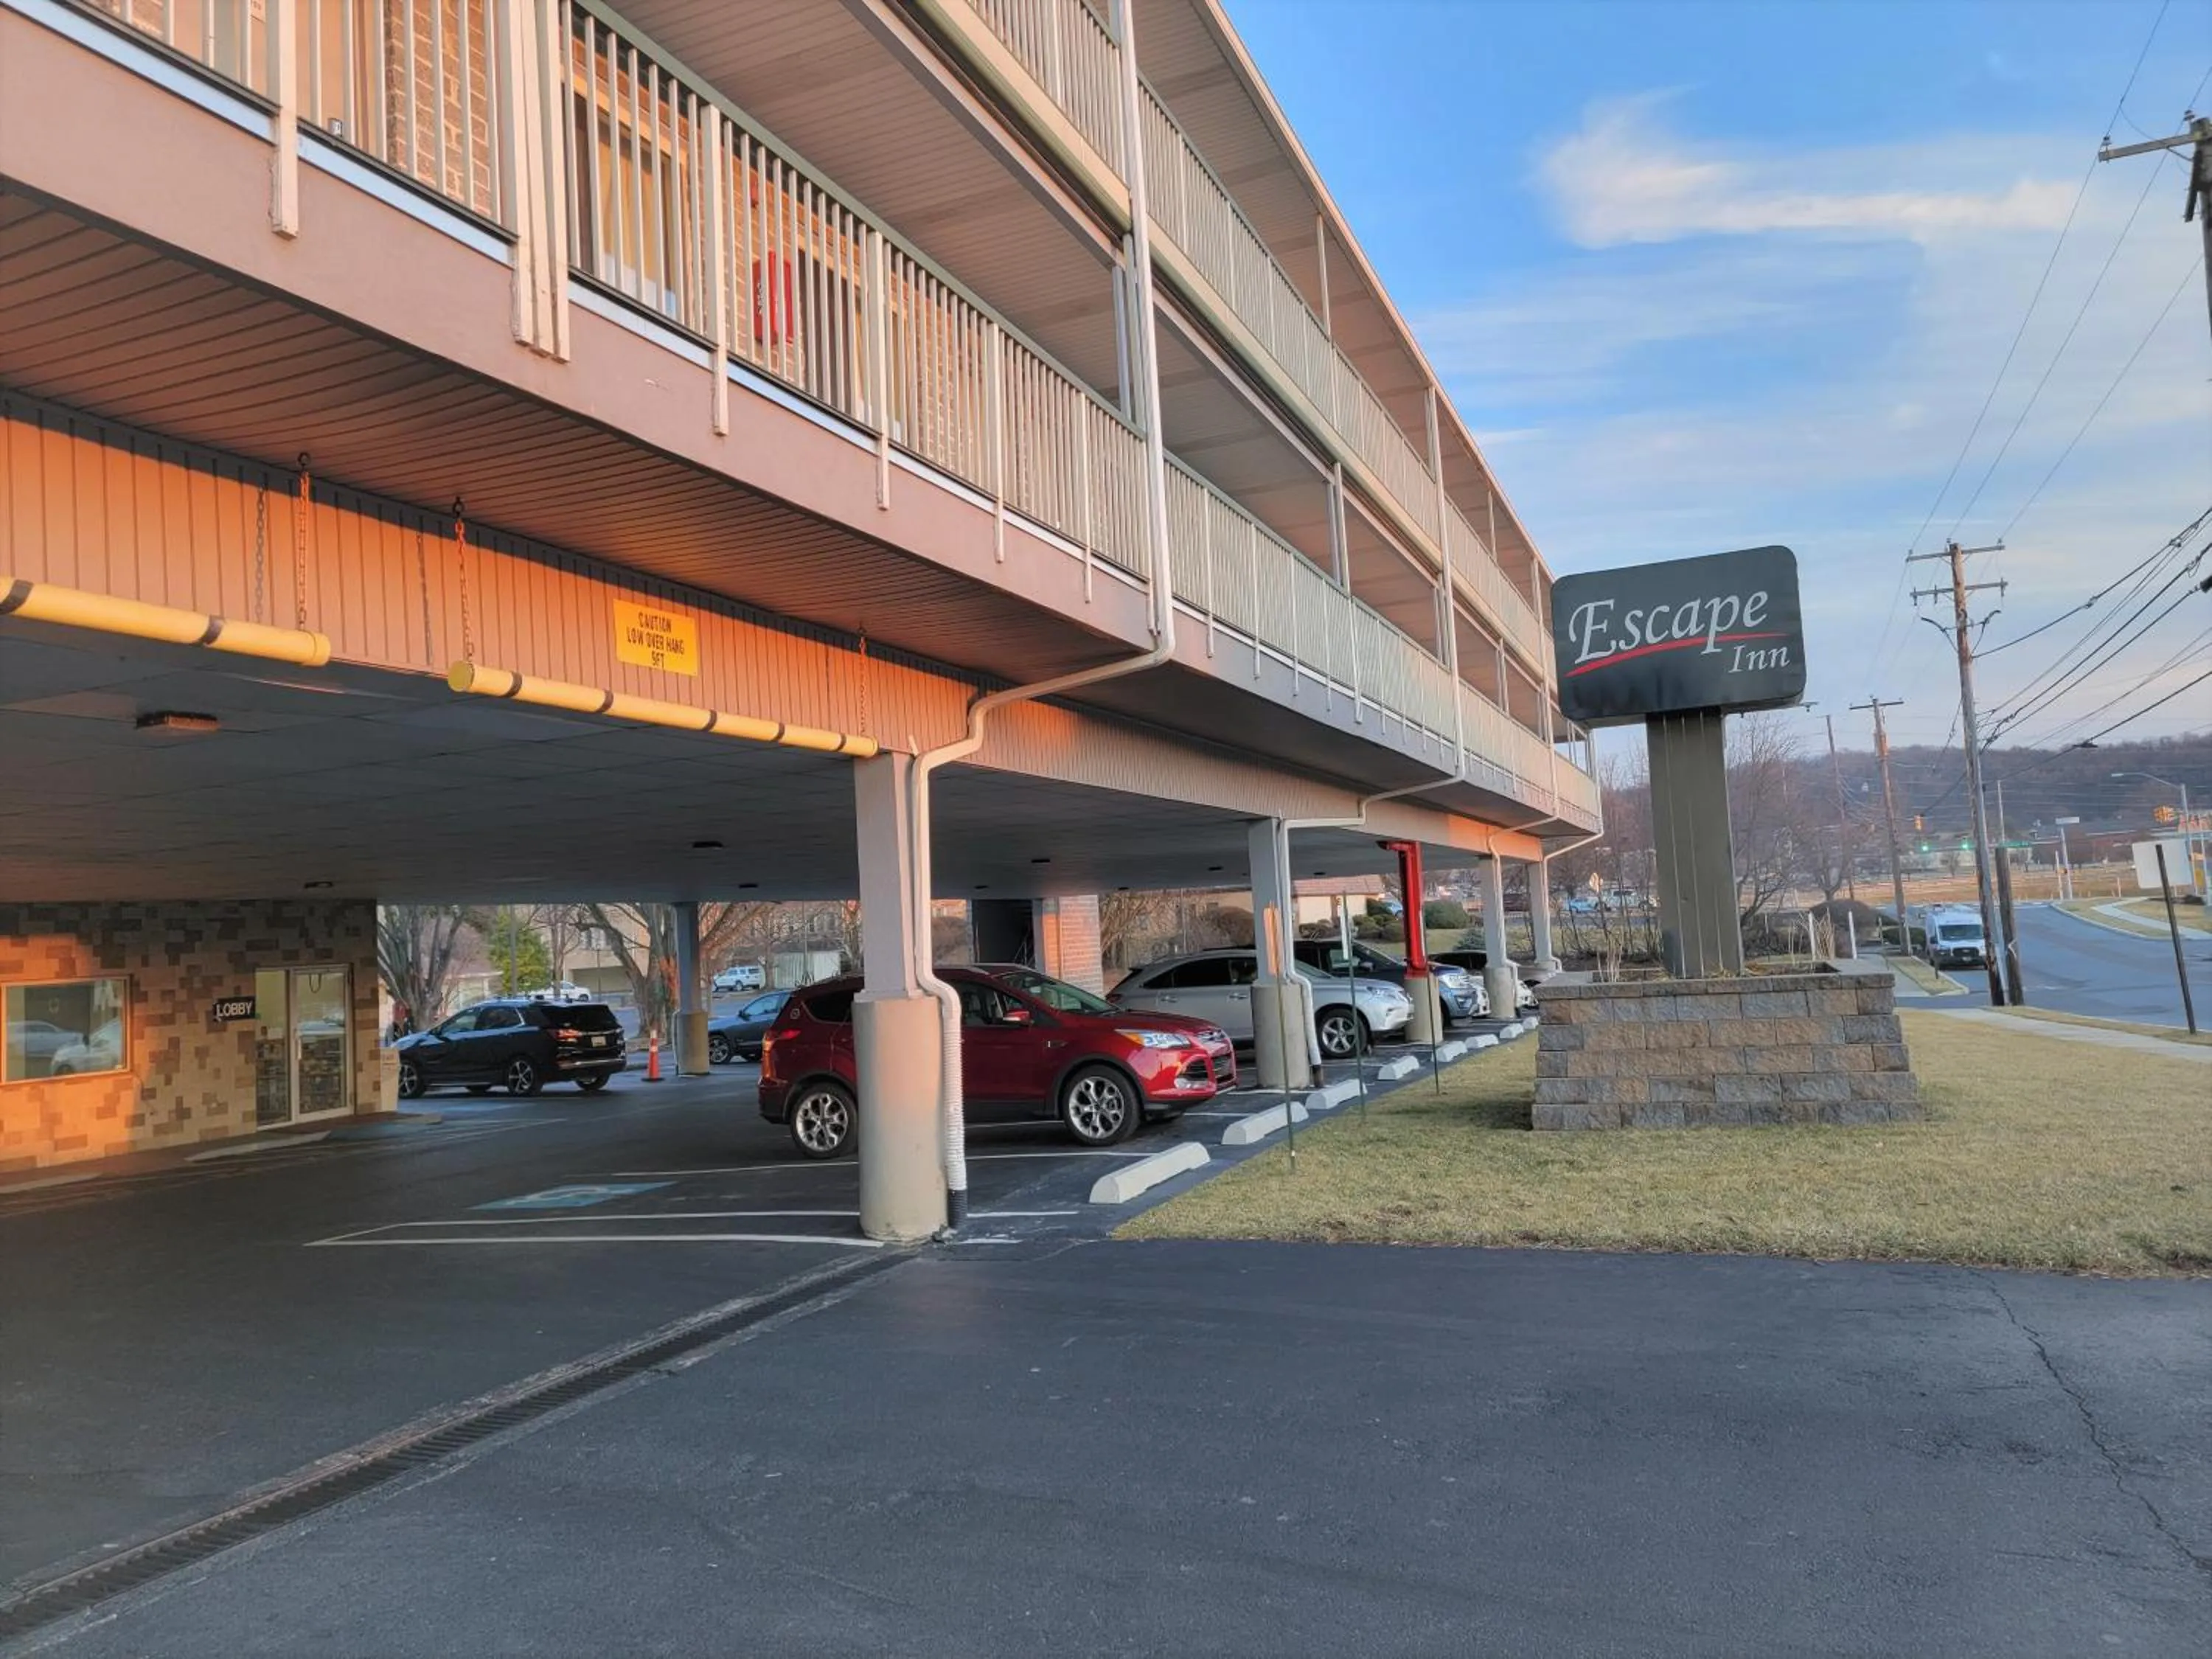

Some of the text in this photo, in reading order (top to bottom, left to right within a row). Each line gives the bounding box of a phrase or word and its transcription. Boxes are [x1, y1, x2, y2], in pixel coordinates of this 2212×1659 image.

[638, 611, 671, 633] CAUTION
[1568, 591, 1768, 664] Escape
[627, 625, 644, 645] LOW
[646, 631, 664, 650] OVER
[1728, 644, 1790, 672] Inn
[217, 1001, 252, 1016] LOBBY
